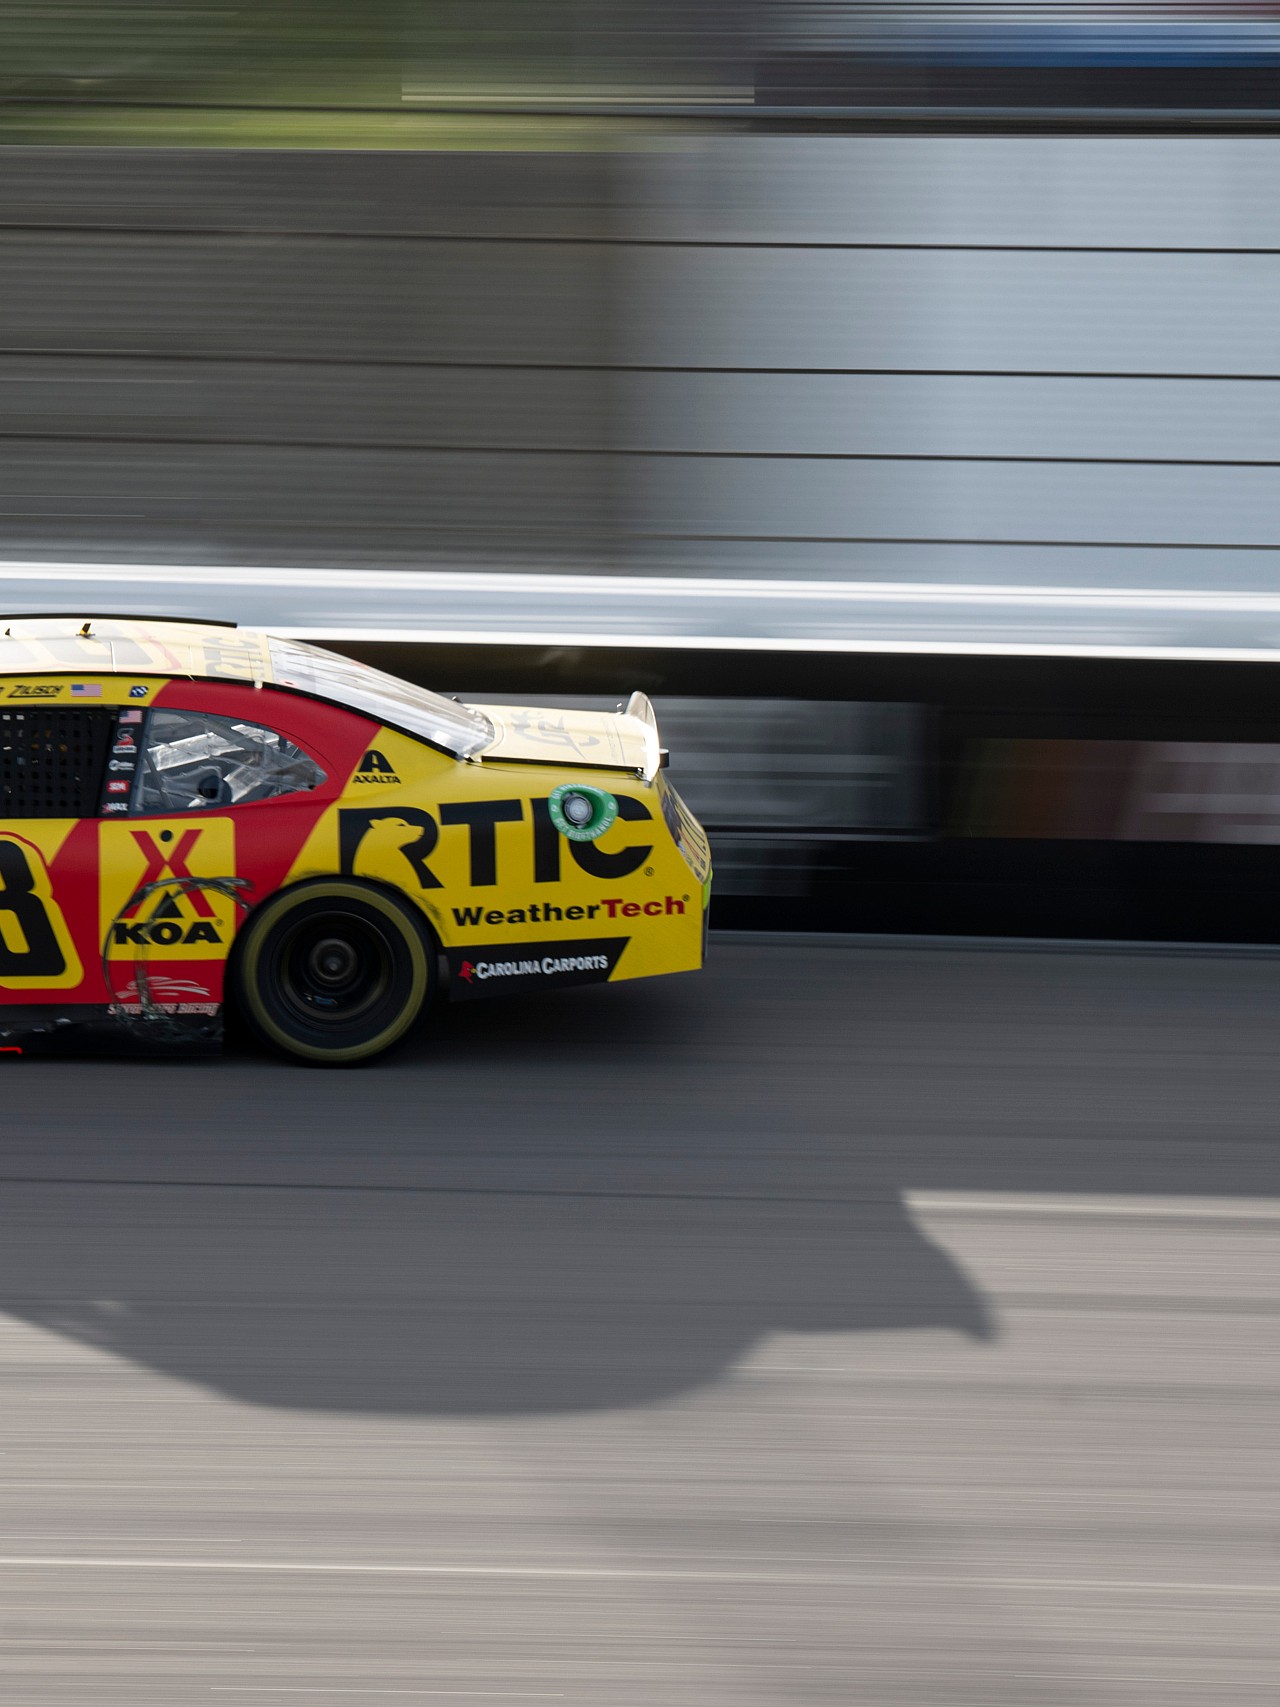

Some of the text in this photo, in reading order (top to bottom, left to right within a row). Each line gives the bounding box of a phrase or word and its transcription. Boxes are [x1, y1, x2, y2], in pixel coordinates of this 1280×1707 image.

[7, 685, 64, 698] ZILISCH
[352, 774, 401, 784] AXALTA
[338, 794, 654, 889] RTIC
[452, 896, 686, 926] WeatherTech
[113, 921, 224, 945] KOA
[476, 955, 609, 979] CAROLINA CARPORTS
